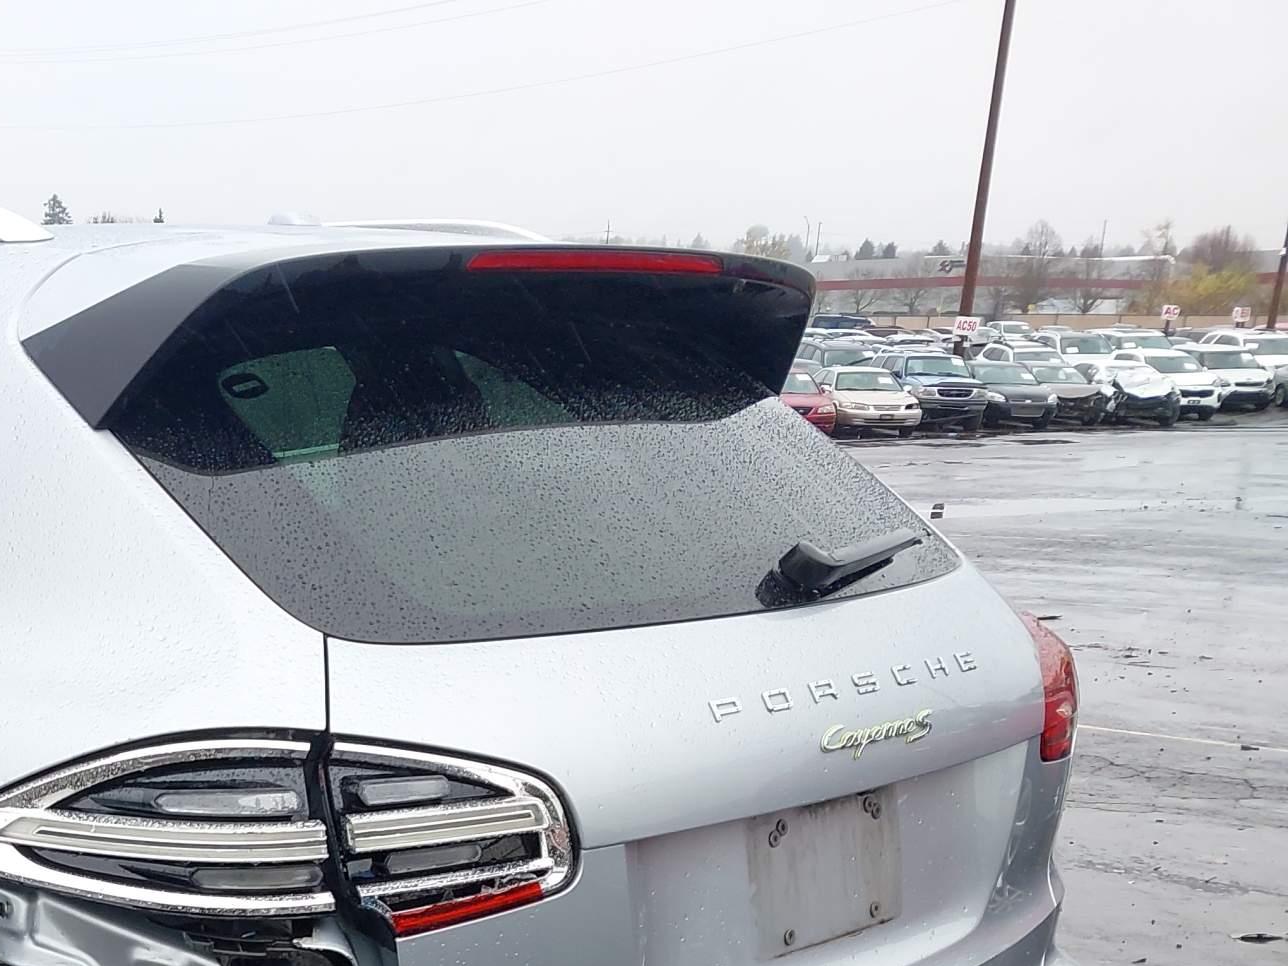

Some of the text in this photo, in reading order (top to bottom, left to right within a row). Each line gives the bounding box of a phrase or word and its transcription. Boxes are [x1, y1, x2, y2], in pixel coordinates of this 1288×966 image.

[956, 319, 978, 332] AC50
[707, 651, 978, 723] PORSCHE
[819, 715, 916, 760] Cayenne
